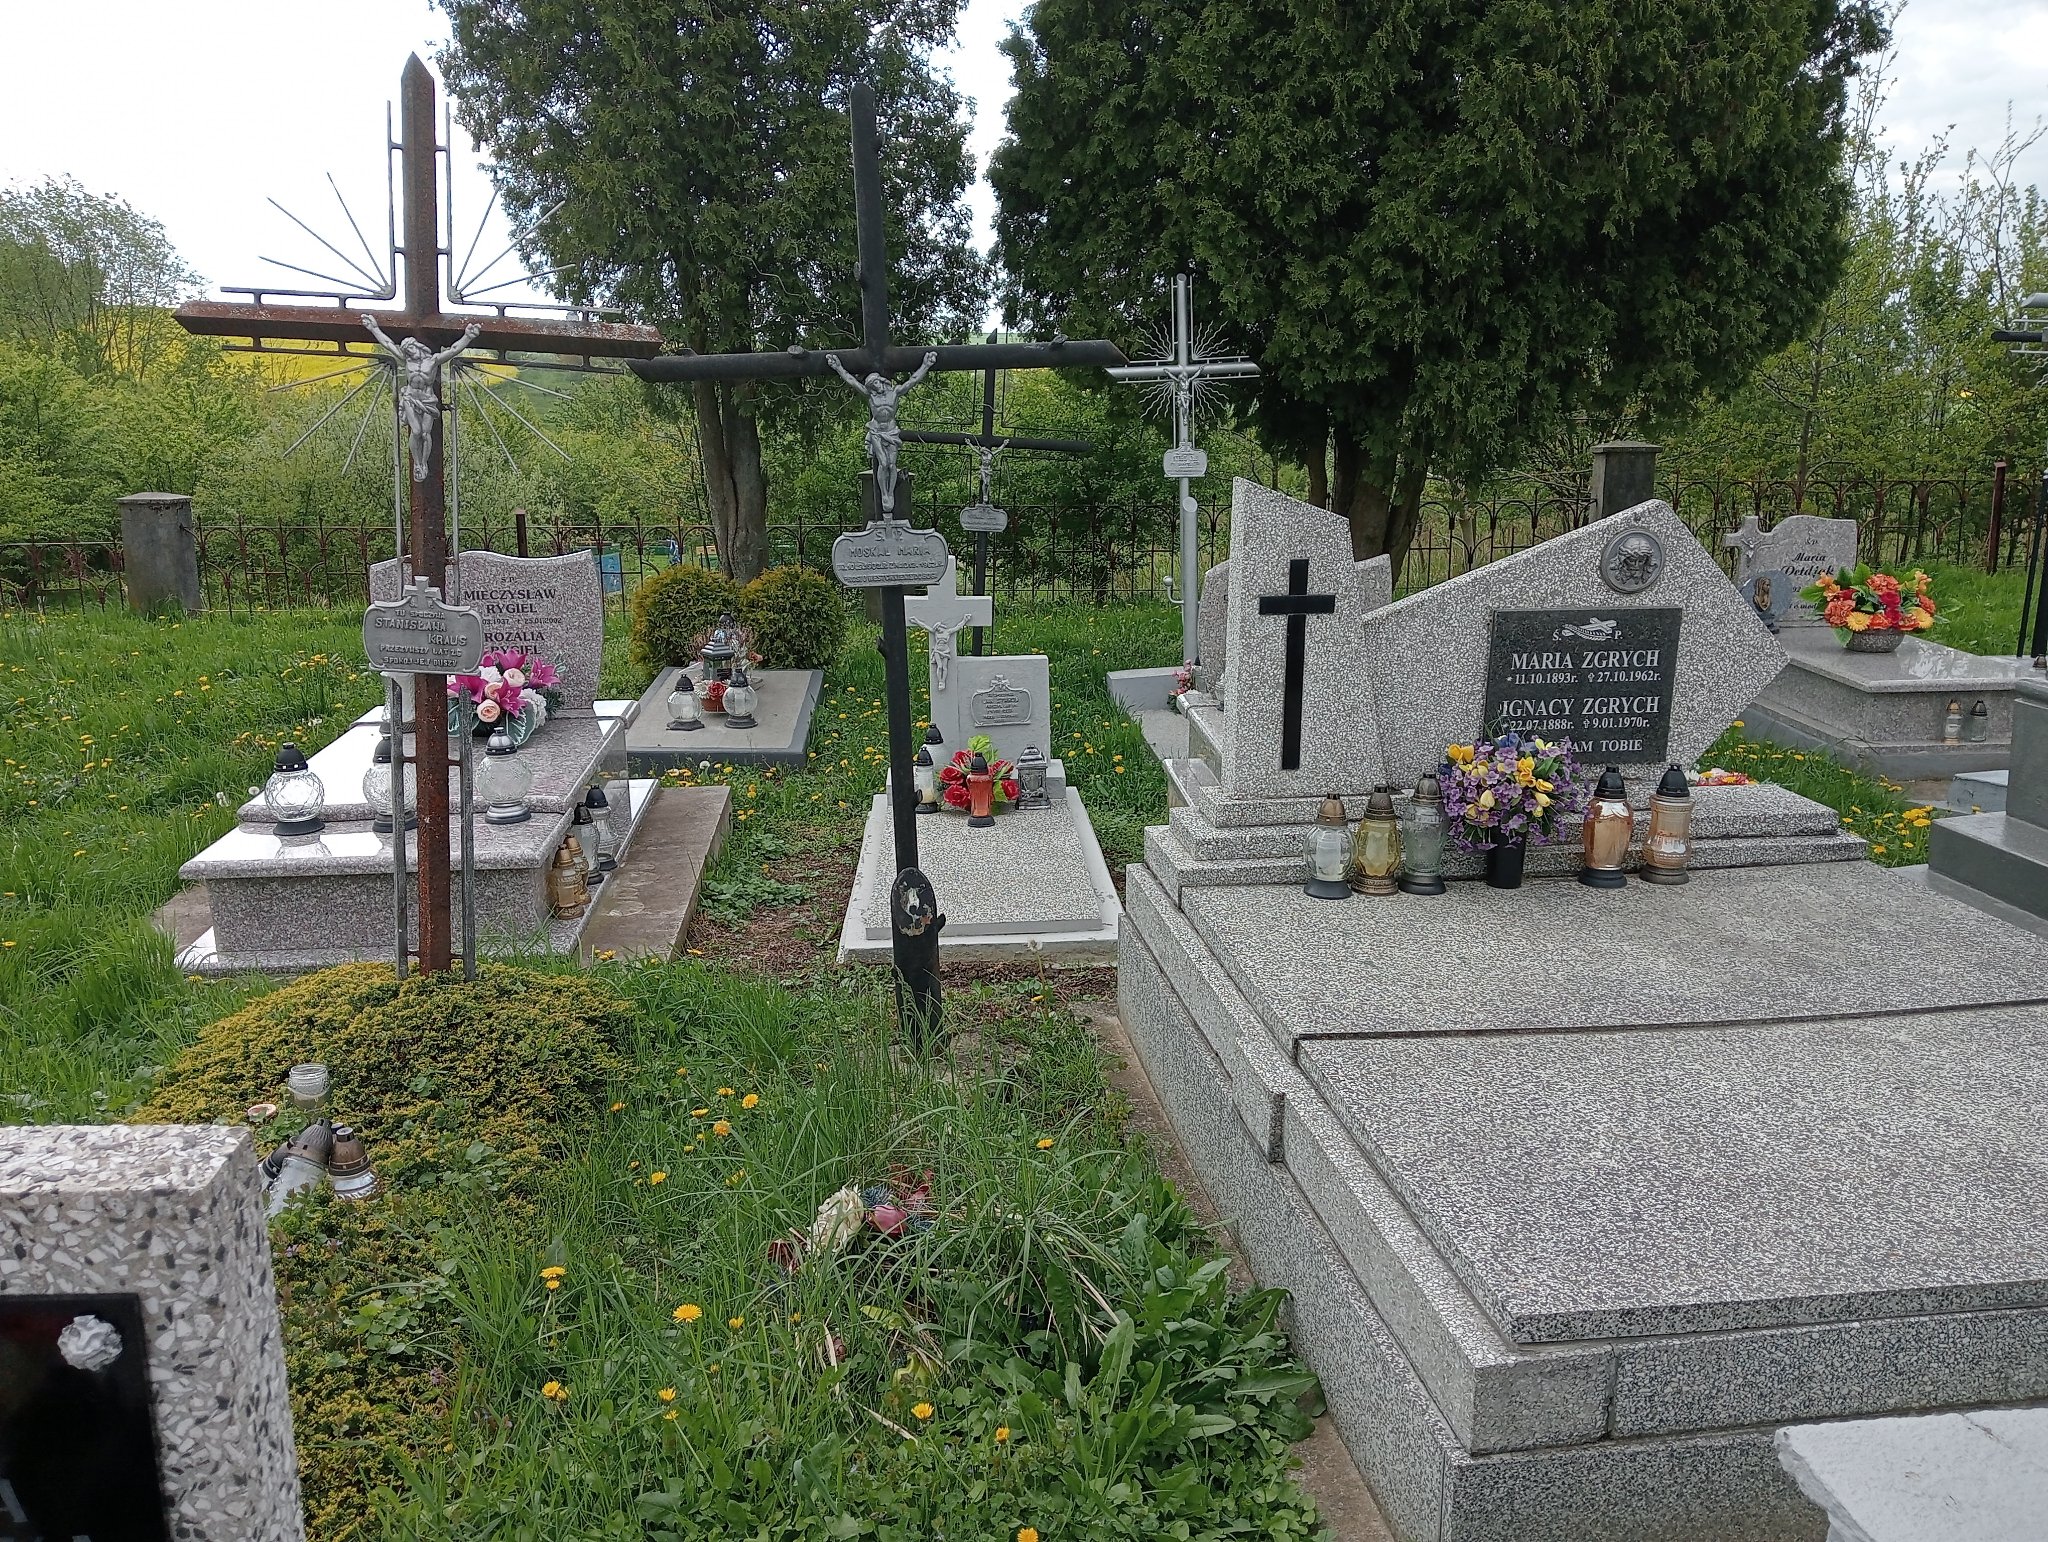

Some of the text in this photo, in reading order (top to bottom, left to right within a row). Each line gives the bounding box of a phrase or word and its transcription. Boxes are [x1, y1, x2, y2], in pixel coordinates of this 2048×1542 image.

[848, 546, 890, 558] MOSKAL
[1791, 552, 1827, 562] Maria
[486, 603, 538, 614] RYGIEL
[375, 618, 447, 632] STANISŁAWA
[428, 633, 468, 646] KRAUS
[484, 631, 546, 643] ROZALIA
[1614, 630, 1624, 640] P.
[1510, 649, 1662, 670] MARIA ZGRYCH
[1501, 696, 1662, 717] IGNACY ZGRYCH
[1600, 739, 1643, 751] TOBIE
